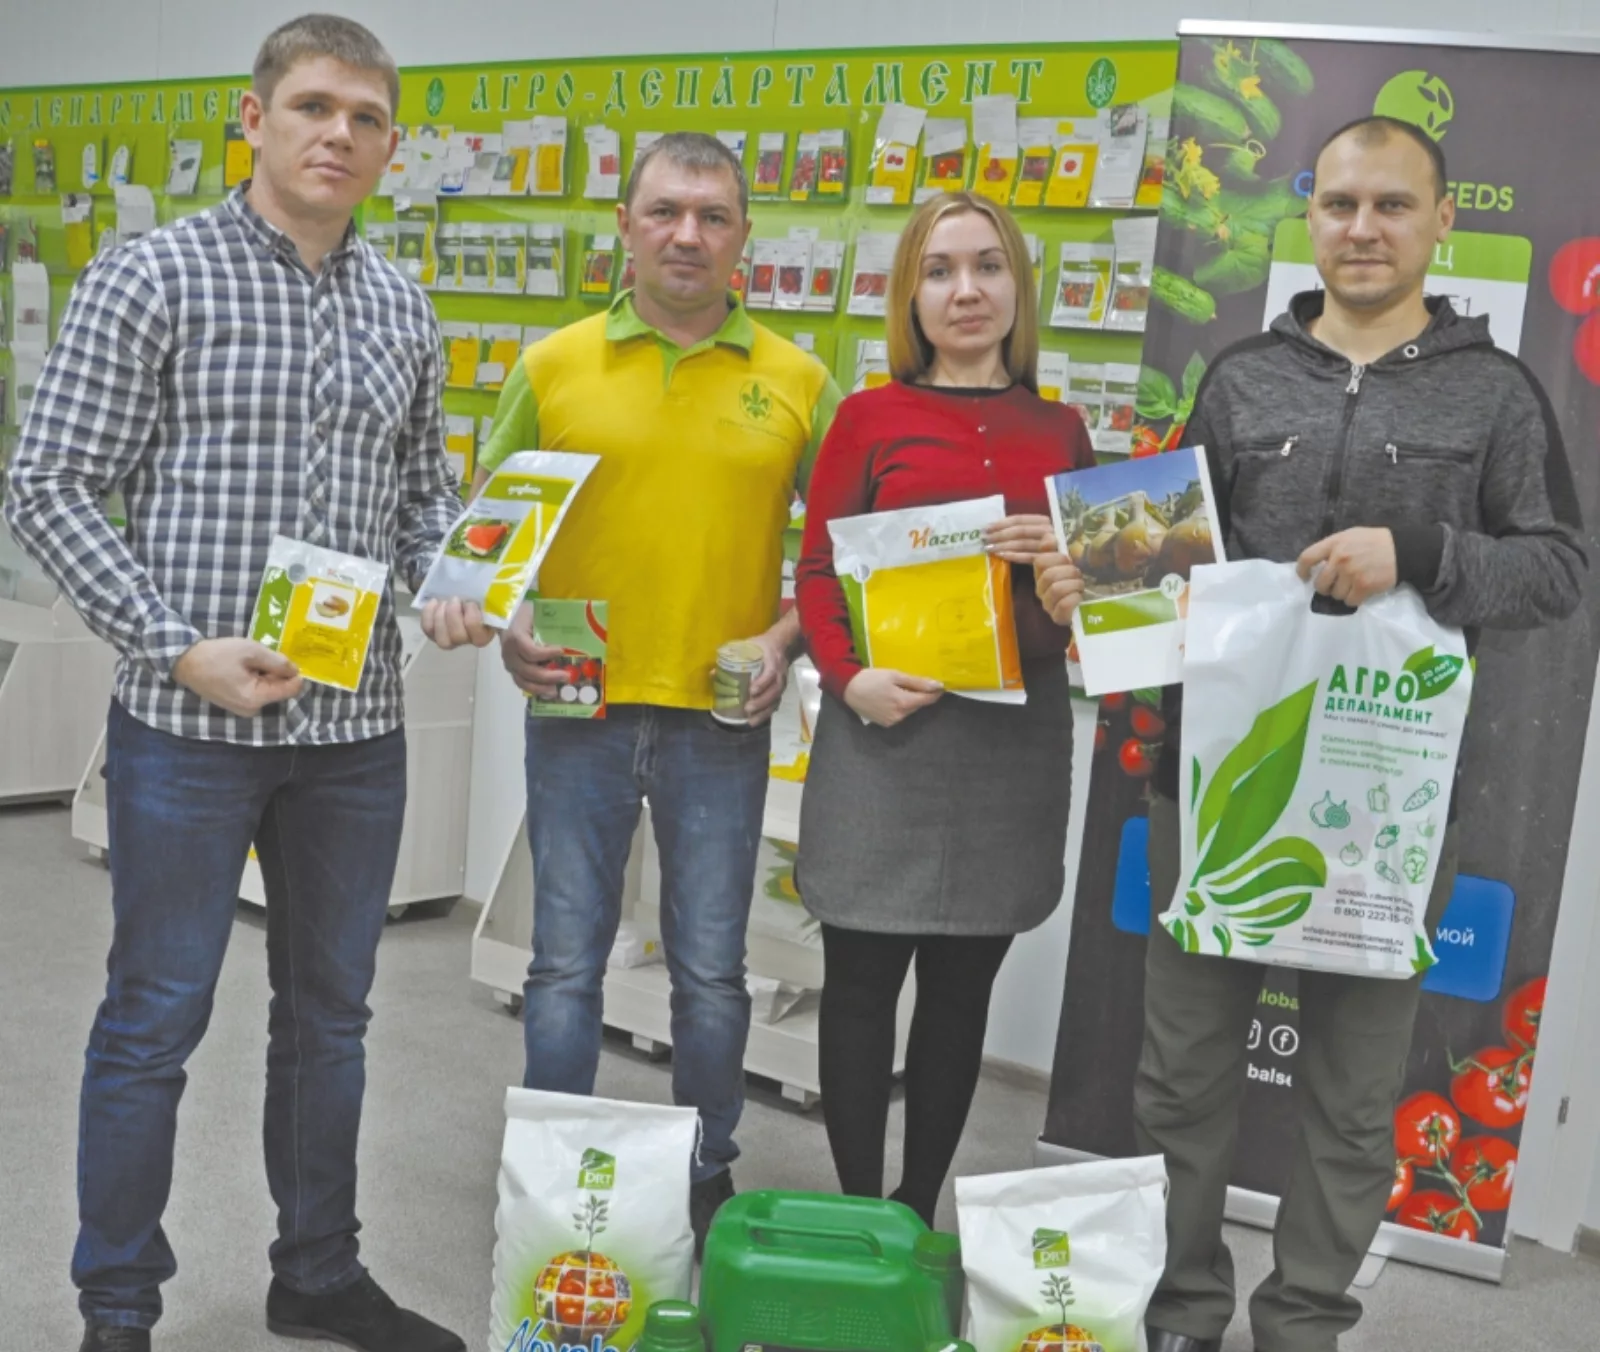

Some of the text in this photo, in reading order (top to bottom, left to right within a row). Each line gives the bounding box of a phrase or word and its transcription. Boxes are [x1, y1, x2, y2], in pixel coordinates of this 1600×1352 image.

[470, 58, 1044, 116] АГРО-ДЕПАРТАМЕНТ
[908, 527, 981, 550] Hazera
[1327, 664, 1415, 703] АГРО
[1324, 696, 1433, 725] ДЕПАРТАМЕНТ
